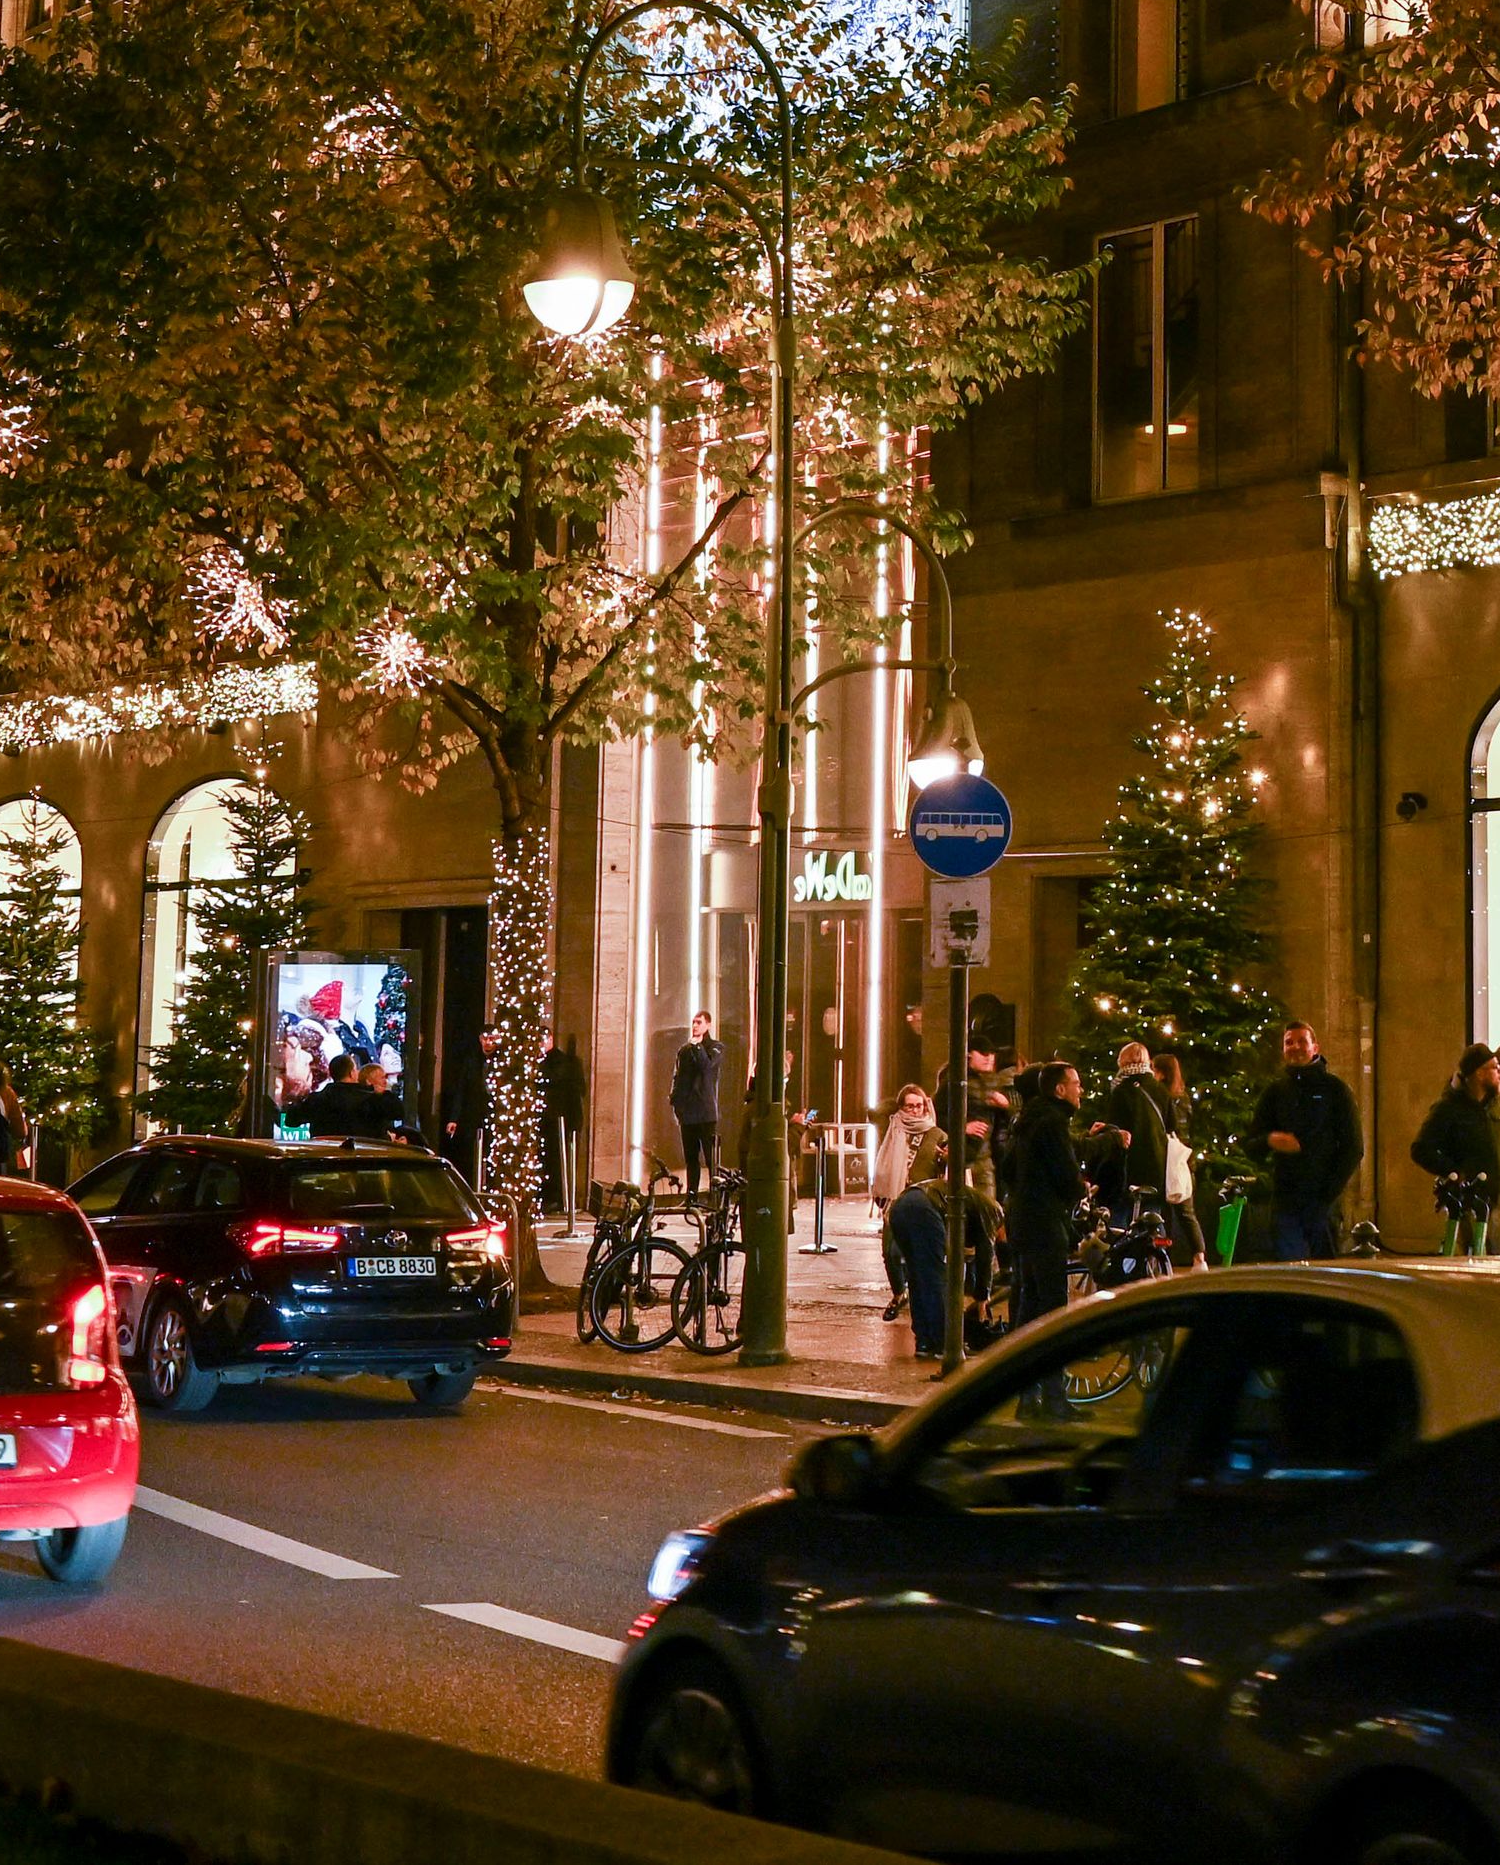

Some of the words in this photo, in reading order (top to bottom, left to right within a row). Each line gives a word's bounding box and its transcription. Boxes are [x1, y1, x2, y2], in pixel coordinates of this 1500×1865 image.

[357, 1259, 367, 1274] B
[376, 1259, 396, 1274] CB
[399, 1259, 435, 1274] 8830
